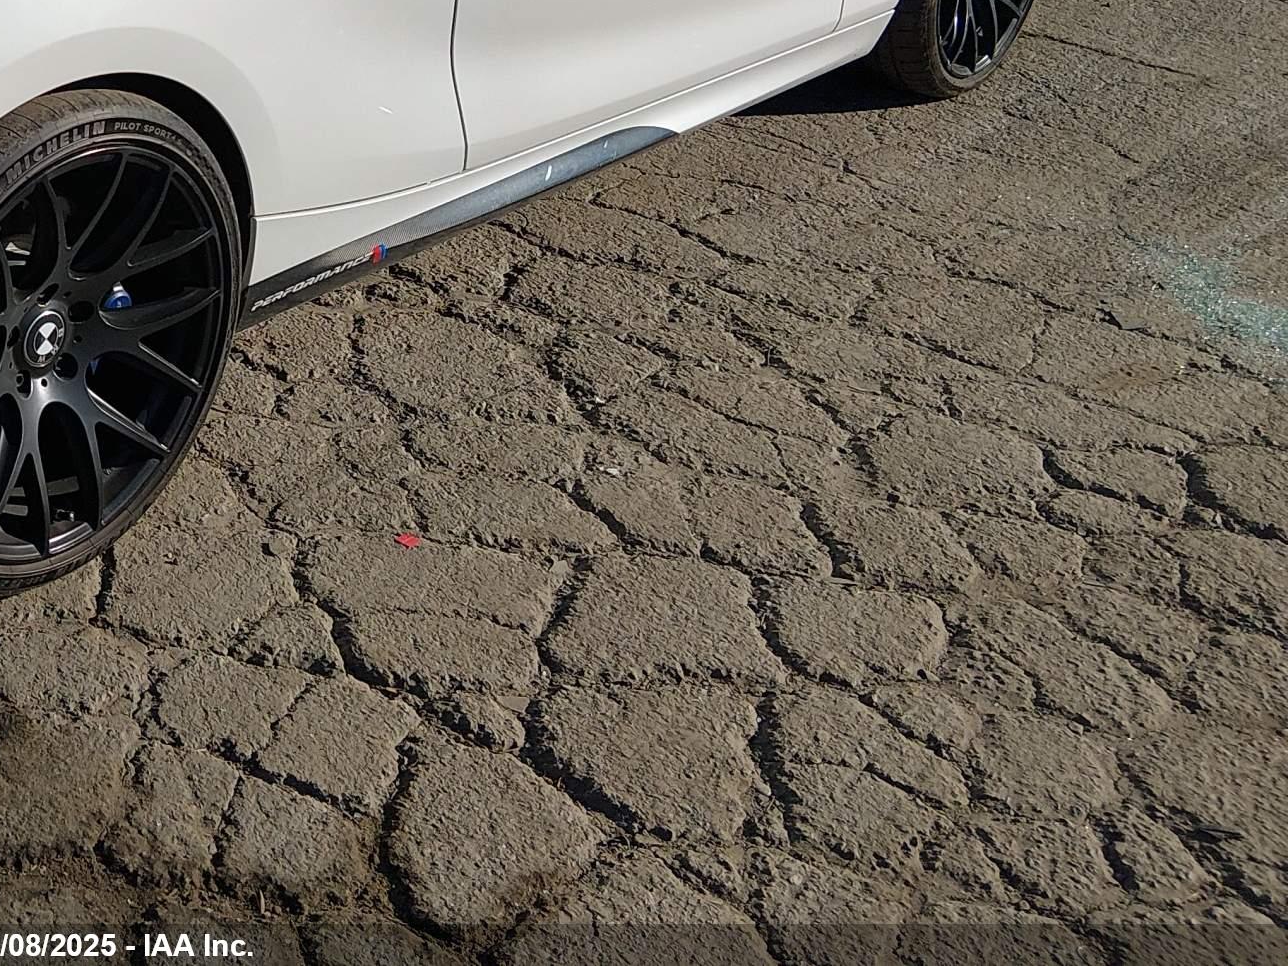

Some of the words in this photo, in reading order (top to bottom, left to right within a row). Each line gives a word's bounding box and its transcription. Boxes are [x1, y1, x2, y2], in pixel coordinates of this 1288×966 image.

[6, 121, 106, 185] MICHELIN
[114, 121, 142, 131] PILOT
[143, 124, 173, 140] SPORT
